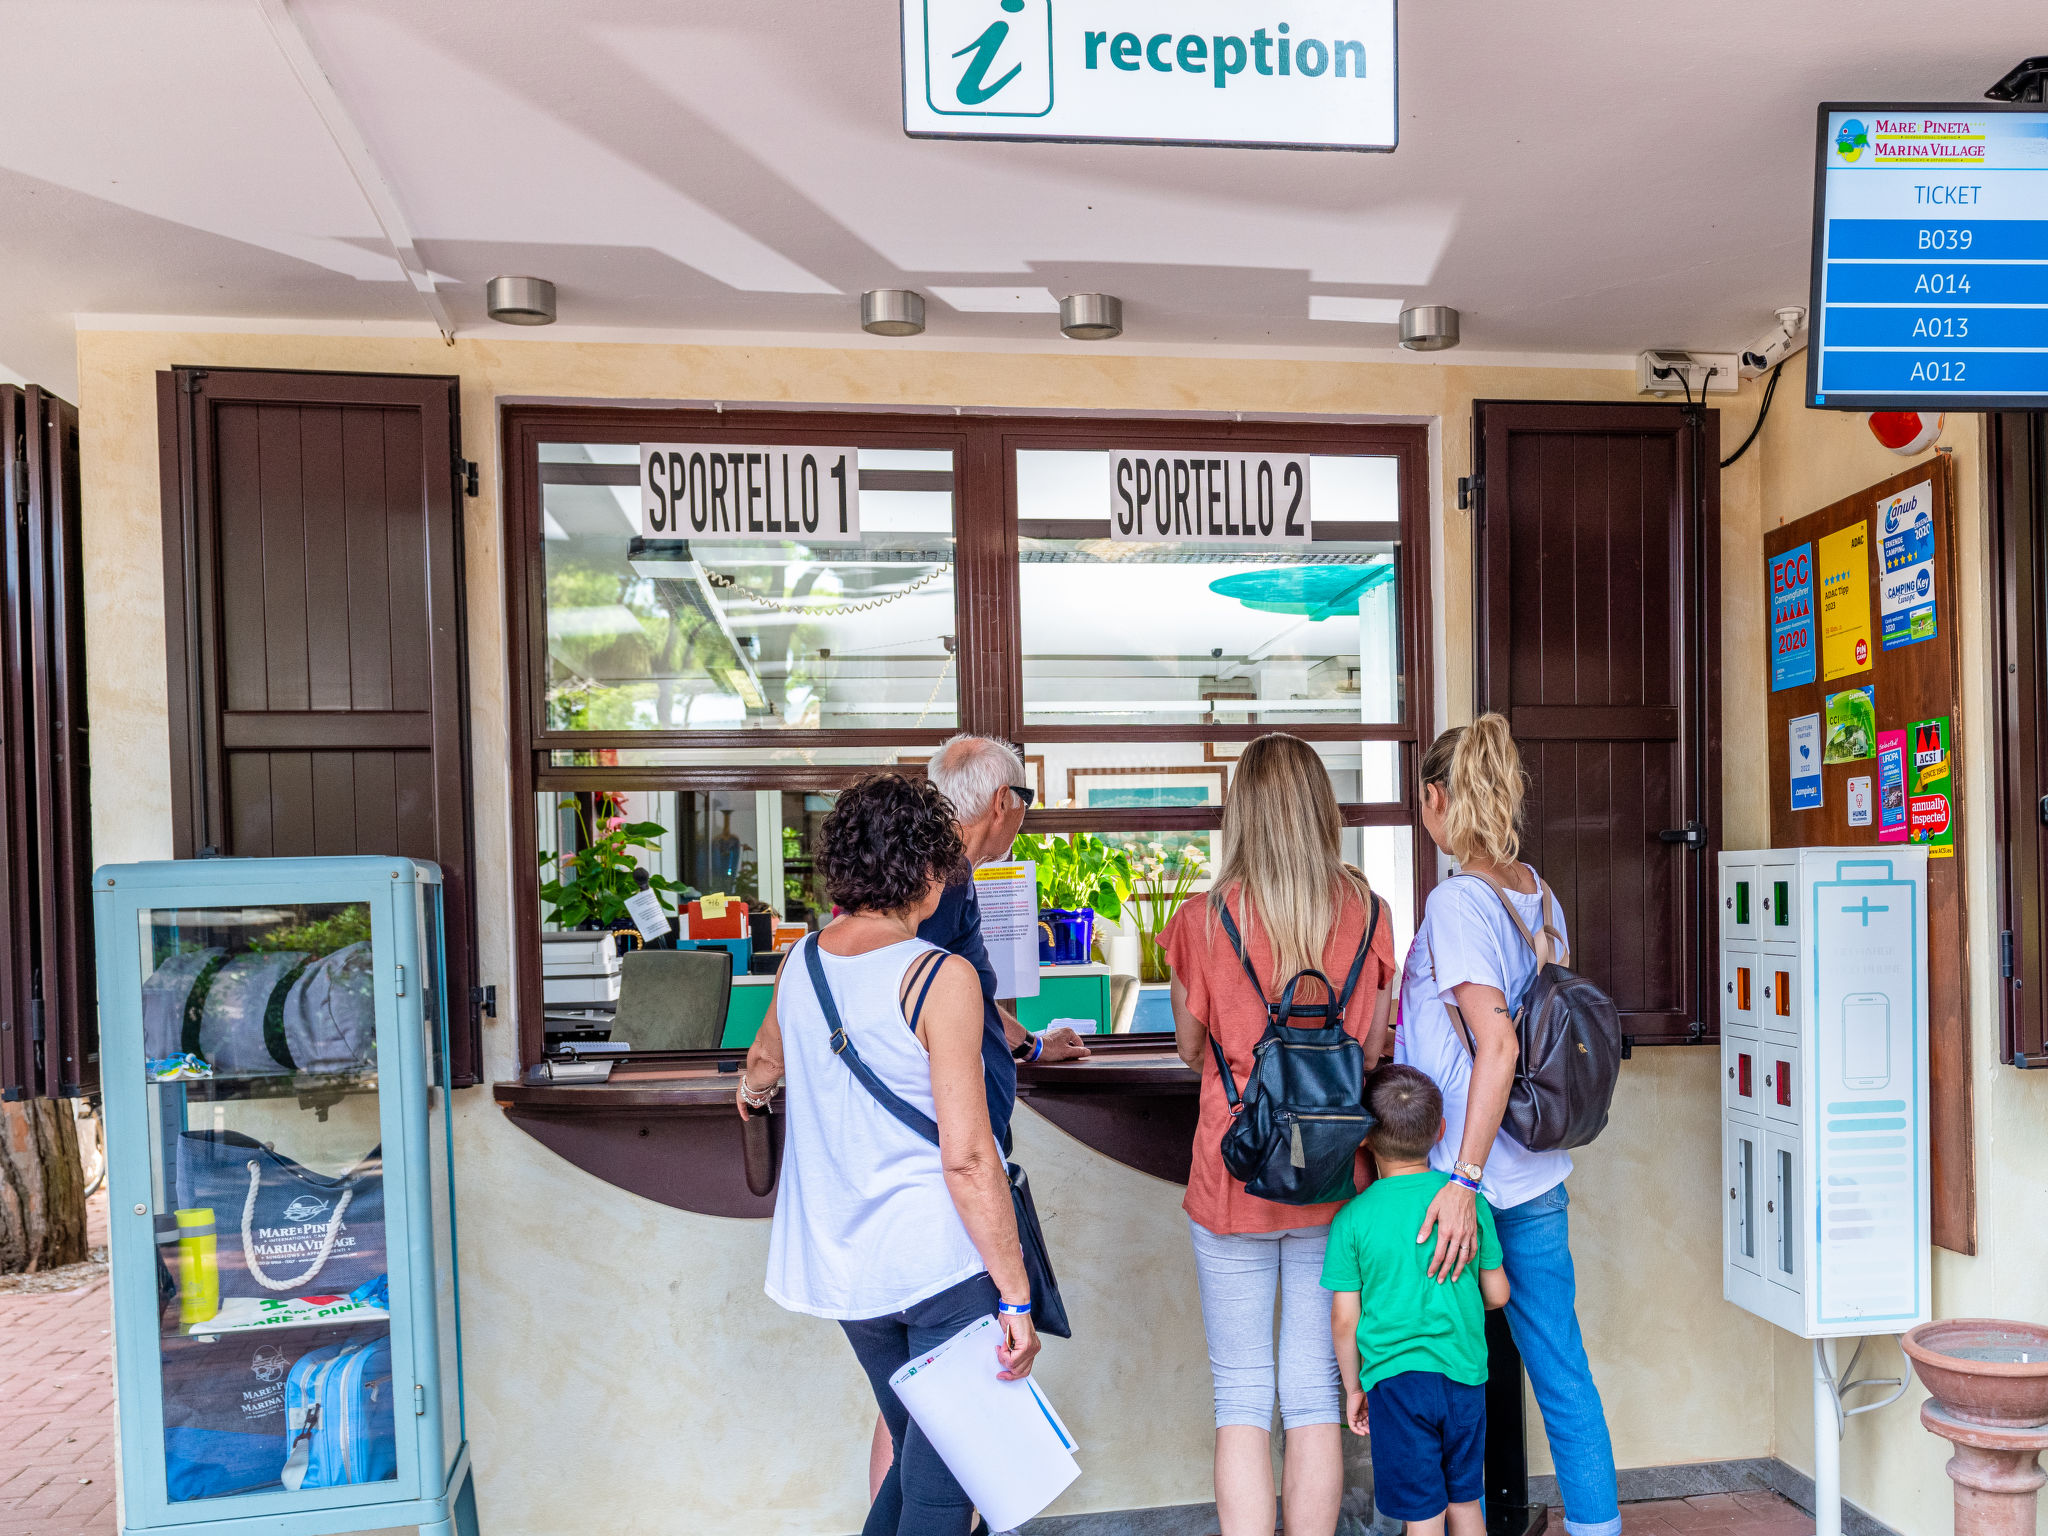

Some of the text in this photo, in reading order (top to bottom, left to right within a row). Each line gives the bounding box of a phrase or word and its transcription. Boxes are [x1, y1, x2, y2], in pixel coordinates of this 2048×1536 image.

[1084, 22, 1367, 88] reception
[1875, 142, 1985, 157] MARINA VILLAGE
[1914, 186, 1982, 204] TICKET
[1918, 229, 1973, 250] B039
[1914, 273, 1971, 294] A014
[1912, 317, 1968, 338] A013
[1910, 361, 1966, 382] A012
[648, 451, 848, 533] SPORTELLO 1
[1116, 457, 1305, 537] SPORTELLO 2
[1891, 495, 1918, 518] anwb
[1914, 523, 1931, 541] 2020
[1851, 535, 1864, 549] ADAC
[1886, 545, 1905, 558] CAMPING
[1774, 554, 1808, 594] ECC
[1775, 587, 1809, 605] Campingführer
[1825, 585, 1849, 600] ADAC Tipp
[1888, 577, 1929, 598] CAMPING Key
[1825, 602, 1836, 612] 2023
[1779, 628, 1807, 654] 2020
[1919, 752, 1936, 763] ACSI
[1923, 770, 1936, 780] SINCE
[1912, 798, 1946, 813] annually
[1912, 810, 1946, 825] inspected
[259, 1227, 297, 1239] MARE
[303, 1222, 347, 1234] PINA
[254, 1242, 305, 1256] MARINA
[304, 1236, 356, 1251] VILAGE
[318, 1301, 367, 1317] PINE
[242, 1387, 272, 1400] MARE
[241, 1396, 282, 1412] MARINA
